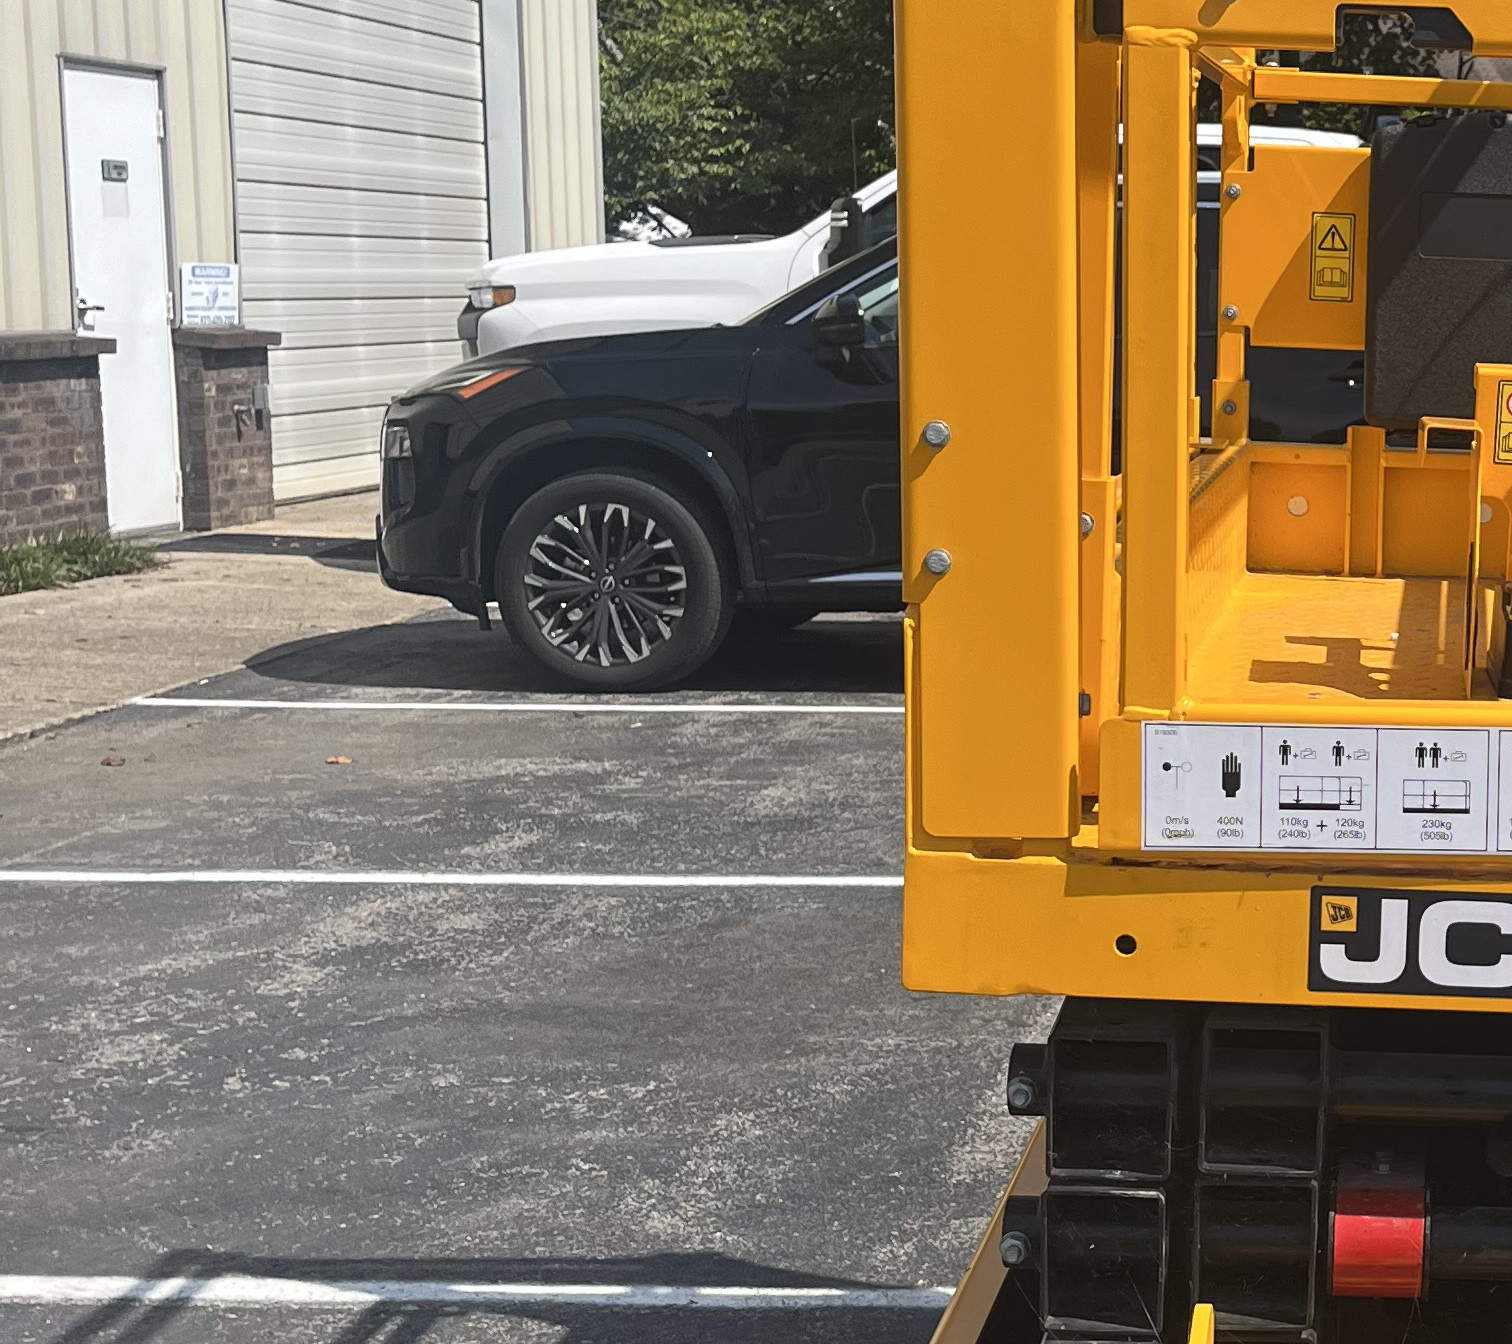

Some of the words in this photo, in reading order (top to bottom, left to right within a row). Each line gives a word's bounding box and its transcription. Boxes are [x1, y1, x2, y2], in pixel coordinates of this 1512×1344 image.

[1165, 815, 1189, 825] 0m/s
[1216, 816, 1244, 825] 400N
[1280, 817, 1309, 828] 110kg
[1335, 818, 1365, 829] 120kg
[1421, 819, 1452, 831] 230kg
[1216, 828, 1244, 839] (90lb)
